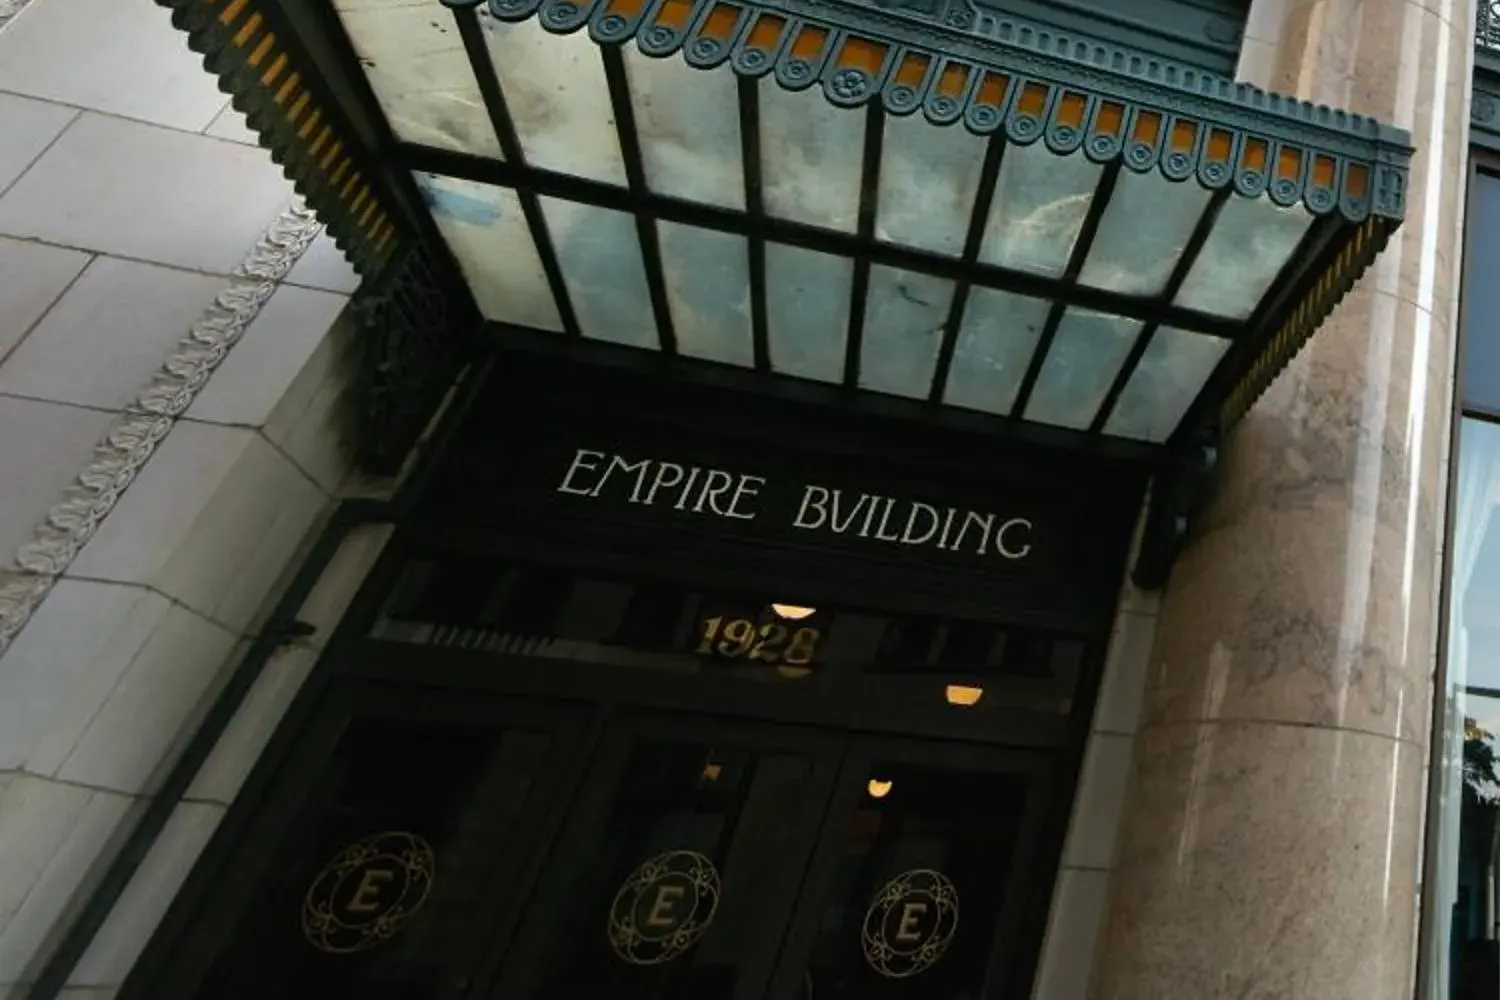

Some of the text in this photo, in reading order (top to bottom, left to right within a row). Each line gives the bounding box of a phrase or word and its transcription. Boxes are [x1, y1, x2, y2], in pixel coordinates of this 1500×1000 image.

[557, 448, 766, 520] EMPIRE
[695, 614, 822, 665] 1928
[348, 870, 391, 911] E
[648, 886, 684, 926] E
[895, 902, 927, 940] E
